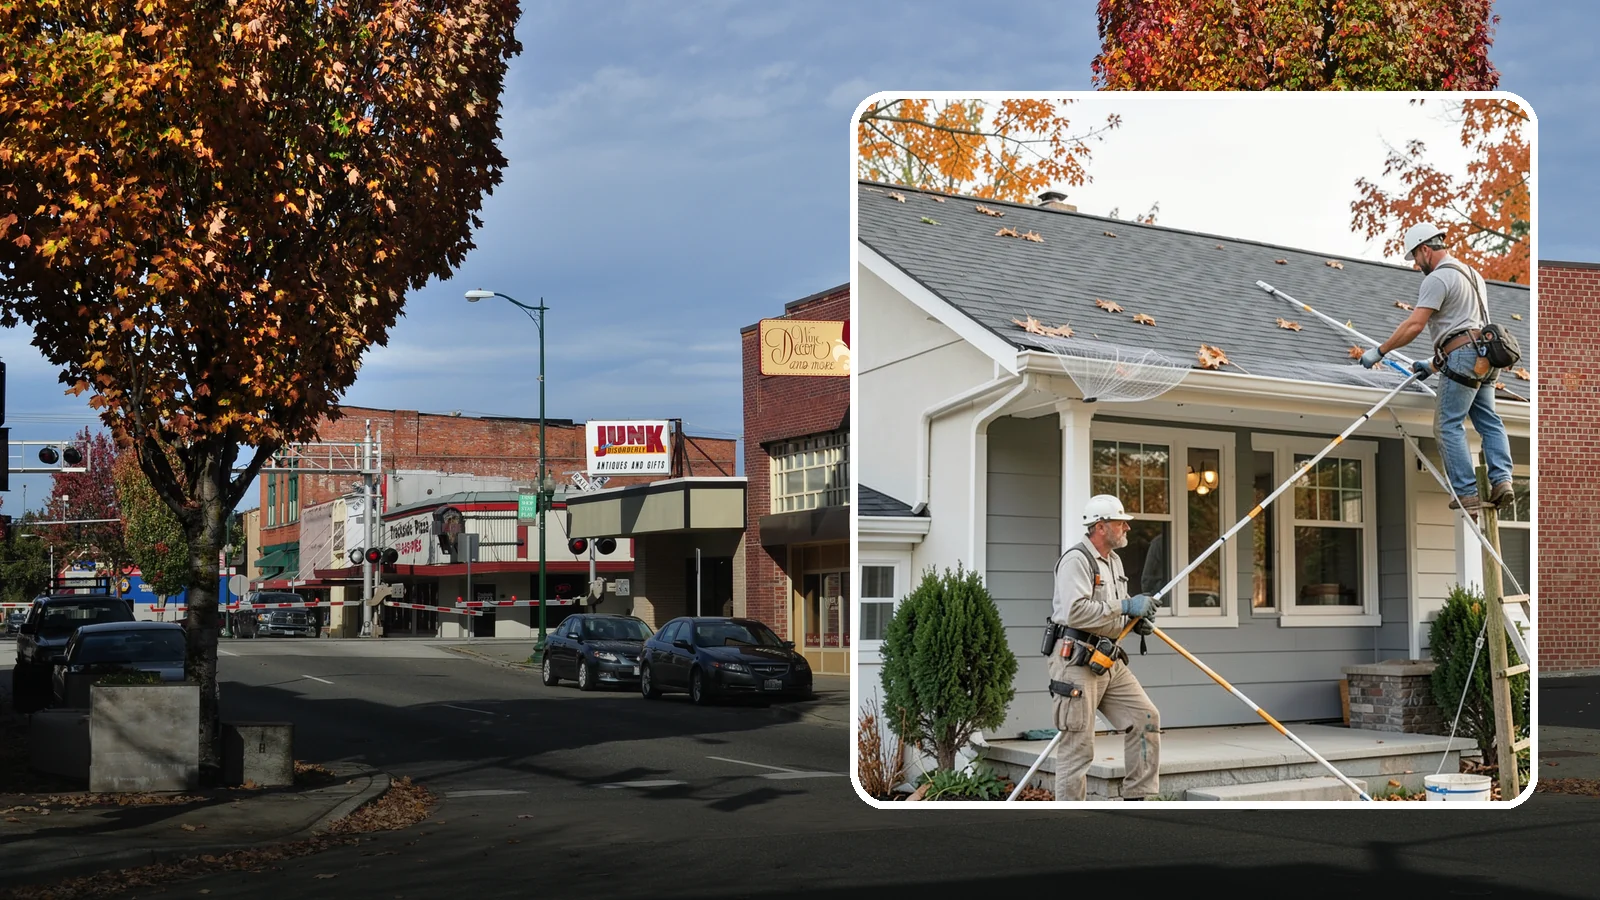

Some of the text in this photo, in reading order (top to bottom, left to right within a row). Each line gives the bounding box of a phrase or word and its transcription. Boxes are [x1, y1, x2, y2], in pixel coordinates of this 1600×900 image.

[596, 426, 665, 457] JUNK
[597, 461, 665, 470] ANTIQUES AND GIFTS
[414, 520, 429, 535] Pizza
